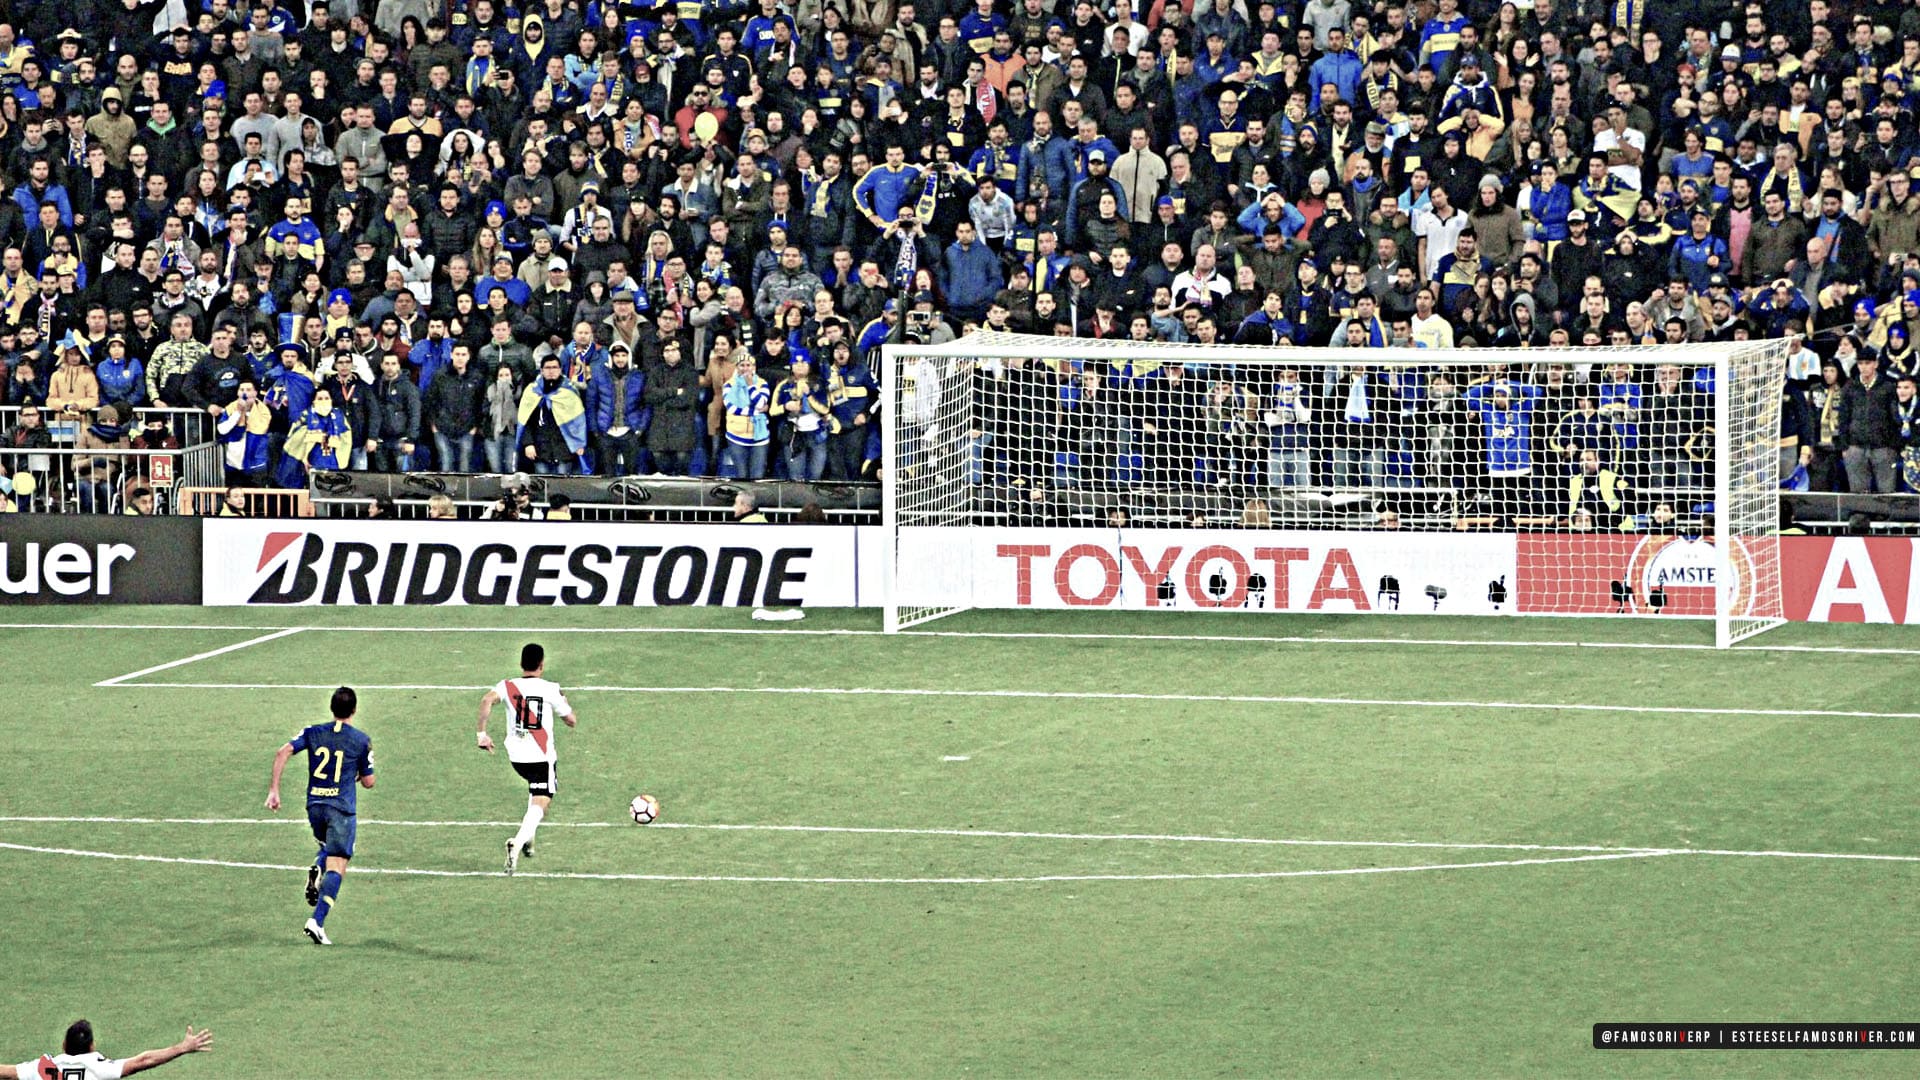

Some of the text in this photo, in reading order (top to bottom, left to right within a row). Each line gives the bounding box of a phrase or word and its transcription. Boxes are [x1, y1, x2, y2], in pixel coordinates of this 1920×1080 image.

[248, 532, 813, 607] BRIDGESTONE
[998, 545, 1371, 611] TOYOTA
[1657, 567, 1716, 583] AMSTE
[1807, 537, 1920, 623] A
[514, 695, 544, 730] 10
[313, 746, 344, 783] 21
